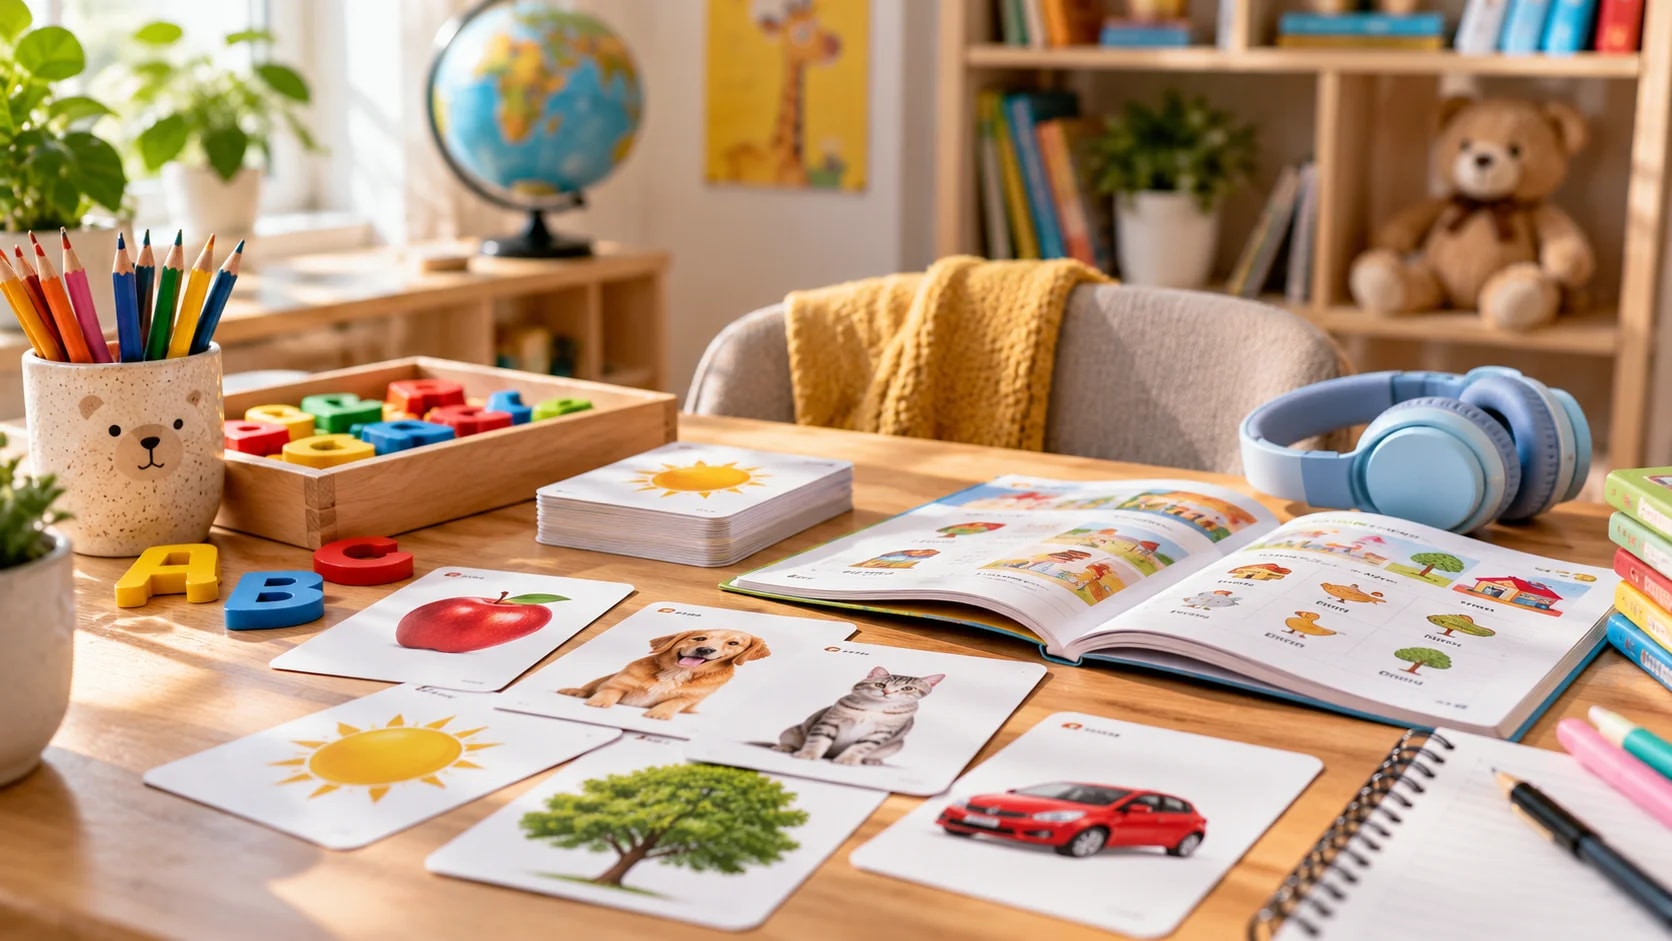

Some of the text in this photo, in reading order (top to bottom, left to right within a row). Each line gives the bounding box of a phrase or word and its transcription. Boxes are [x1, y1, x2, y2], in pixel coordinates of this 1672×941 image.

[114, 536, 413, 630] A B C
